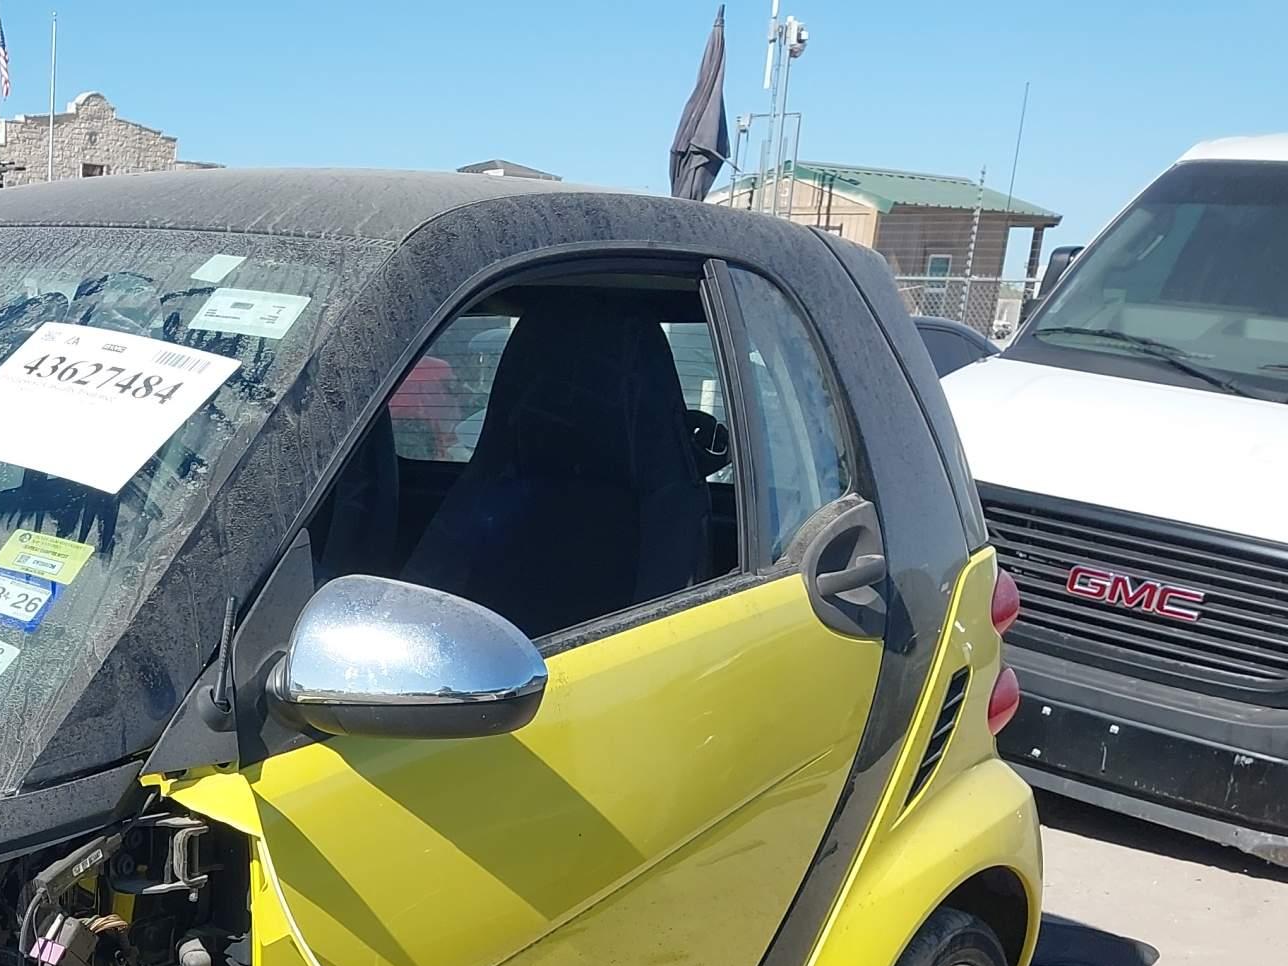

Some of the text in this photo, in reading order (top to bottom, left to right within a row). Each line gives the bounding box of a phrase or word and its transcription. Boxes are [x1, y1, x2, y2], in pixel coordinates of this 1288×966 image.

[23, 354, 184, 405] 43627484
[10, 593, 42, 613] 26
[1067, 565, 1204, 621] GMC
